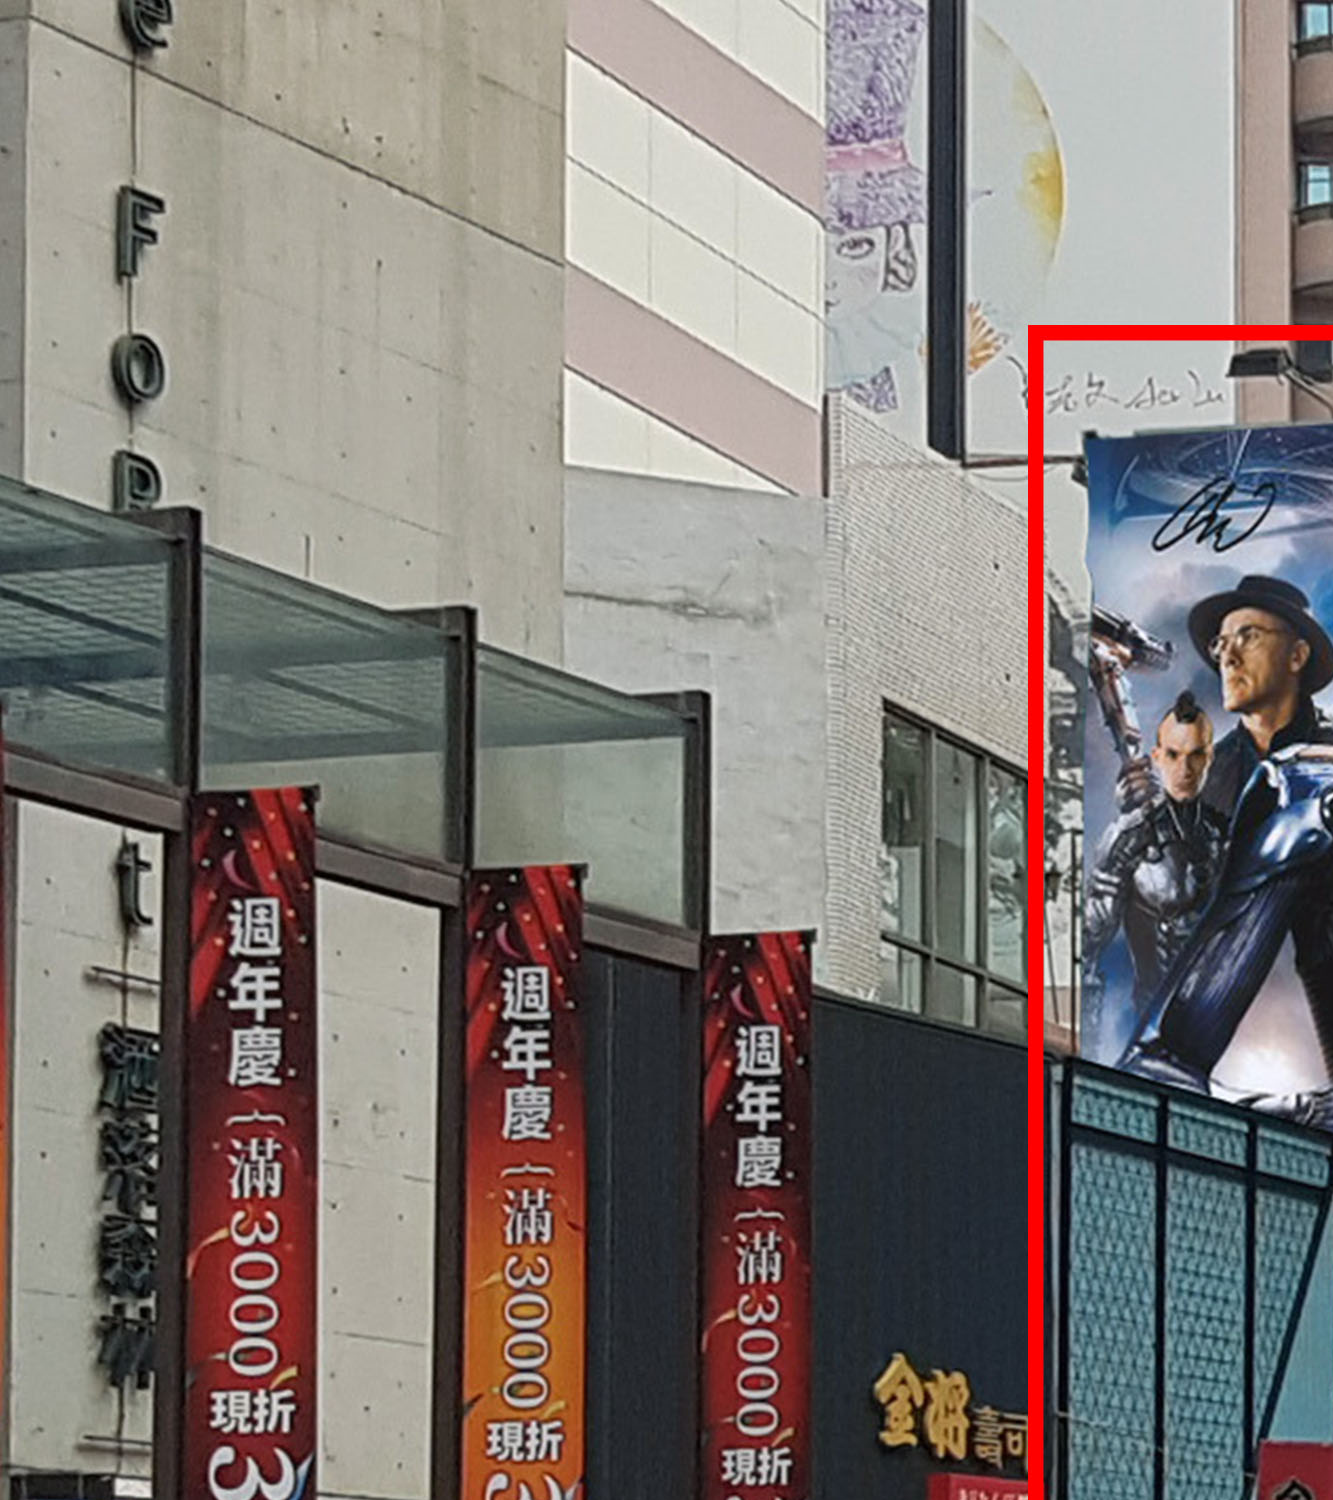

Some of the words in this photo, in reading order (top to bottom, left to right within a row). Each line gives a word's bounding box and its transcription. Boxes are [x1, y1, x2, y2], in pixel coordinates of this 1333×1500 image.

[227, 896, 284, 1088] 週年慶
[500, 965, 552, 1142] 週年慶
[735, 1024, 783, 1188] 週年慶
[209, 1389, 296, 1434] 現折
[486, 1420, 565, 1463] 現折
[721, 1447, 794, 1487] 現折
